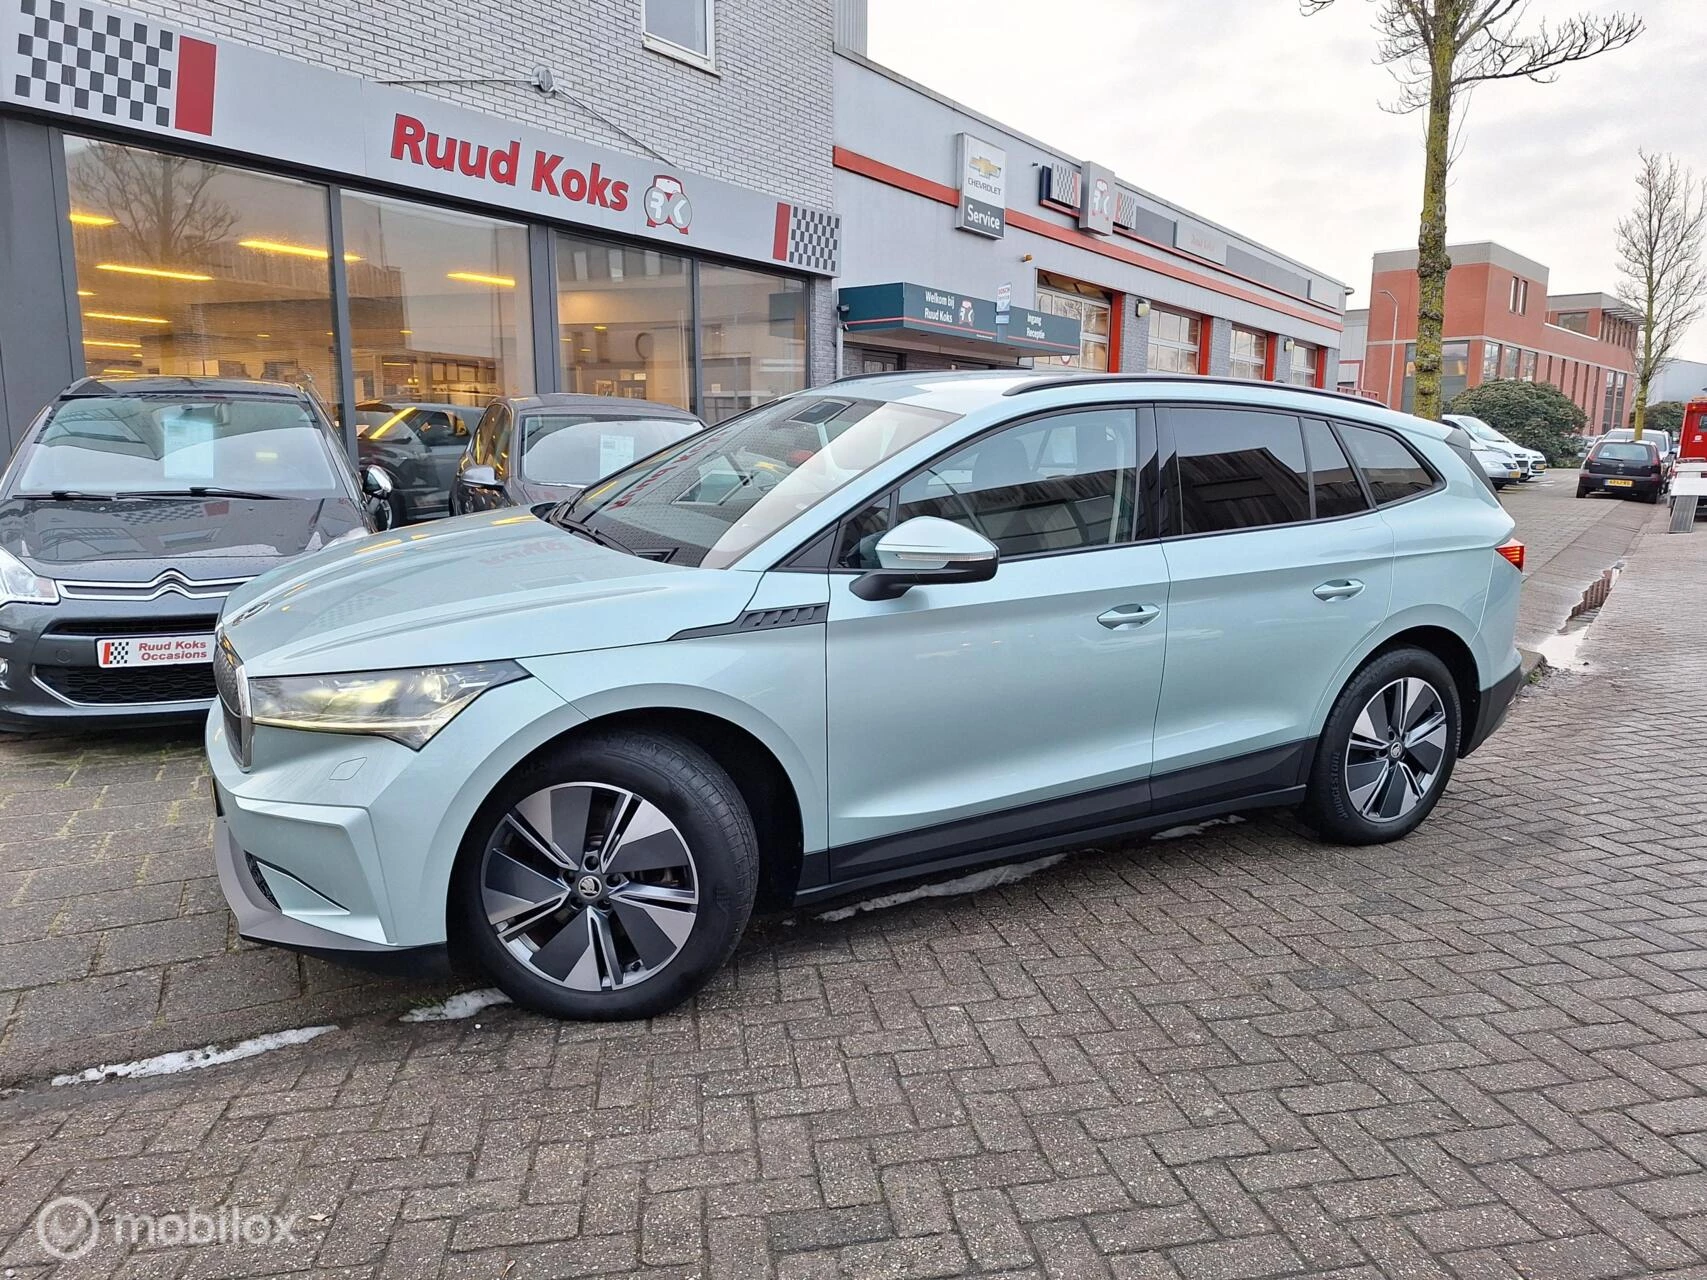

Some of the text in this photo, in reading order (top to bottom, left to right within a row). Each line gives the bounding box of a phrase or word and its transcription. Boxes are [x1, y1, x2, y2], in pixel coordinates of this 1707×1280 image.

[390, 113, 629, 211] Ruud Koks
[967, 177, 1001, 195] CHEVROLET
[967, 204, 1000, 229] Service
[925, 290, 947, 306] Welkom
[924, 308, 953, 323] Ruud Koks
[139, 641, 207, 651] Ruud Koks
[141, 651, 207, 661] Occasions
